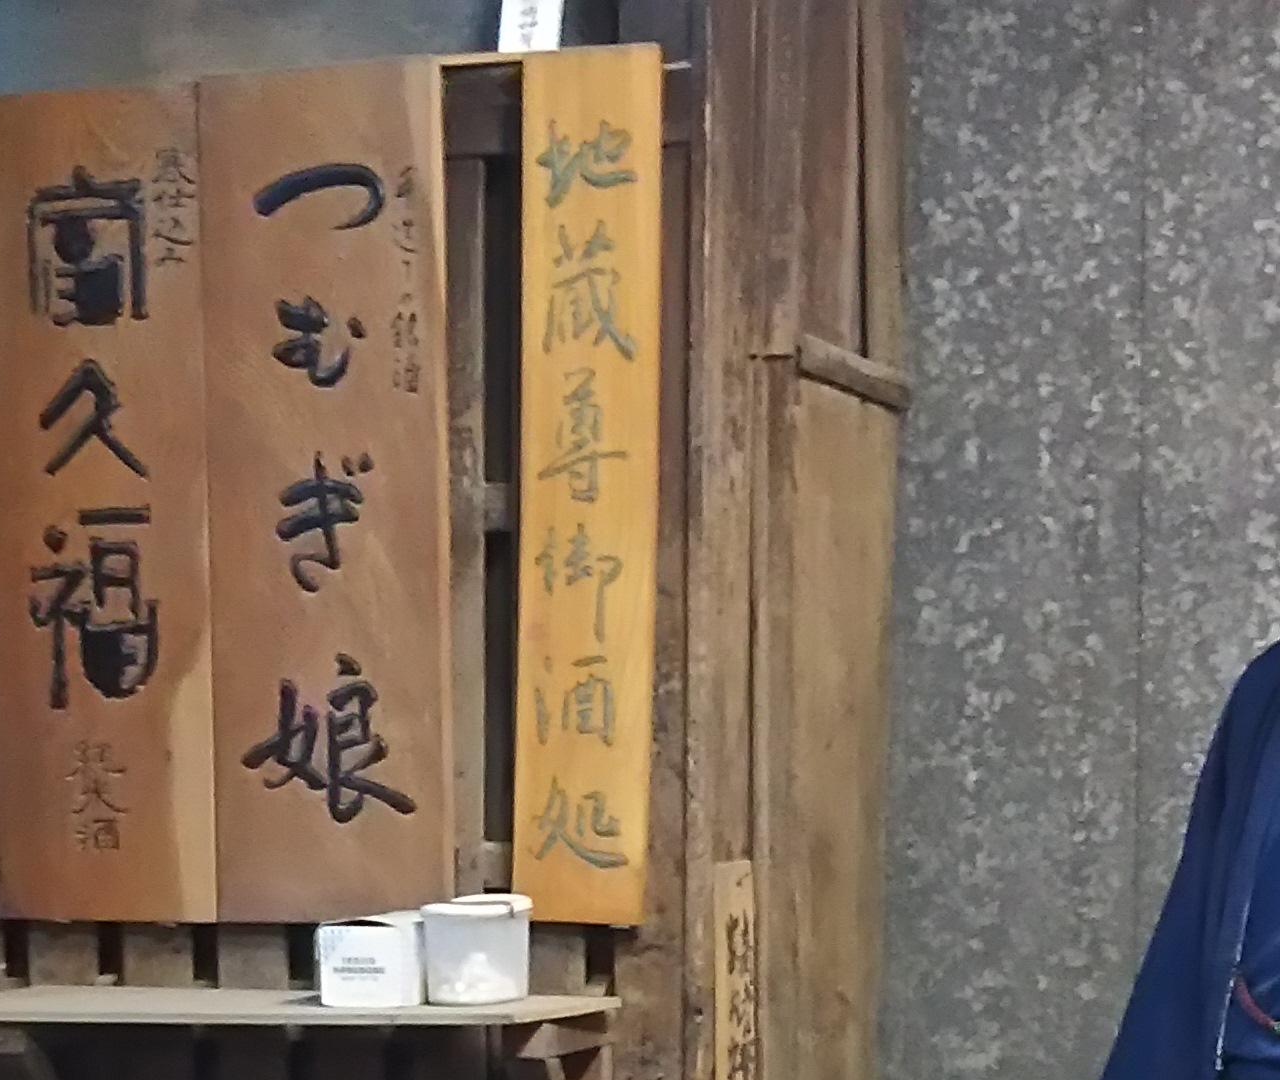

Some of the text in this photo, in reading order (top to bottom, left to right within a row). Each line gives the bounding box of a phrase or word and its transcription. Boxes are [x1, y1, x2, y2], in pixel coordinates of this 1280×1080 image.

[240, 161, 418, 826] つむぎ娘
[526, 118, 638, 868] 地蔵尊御酒処
